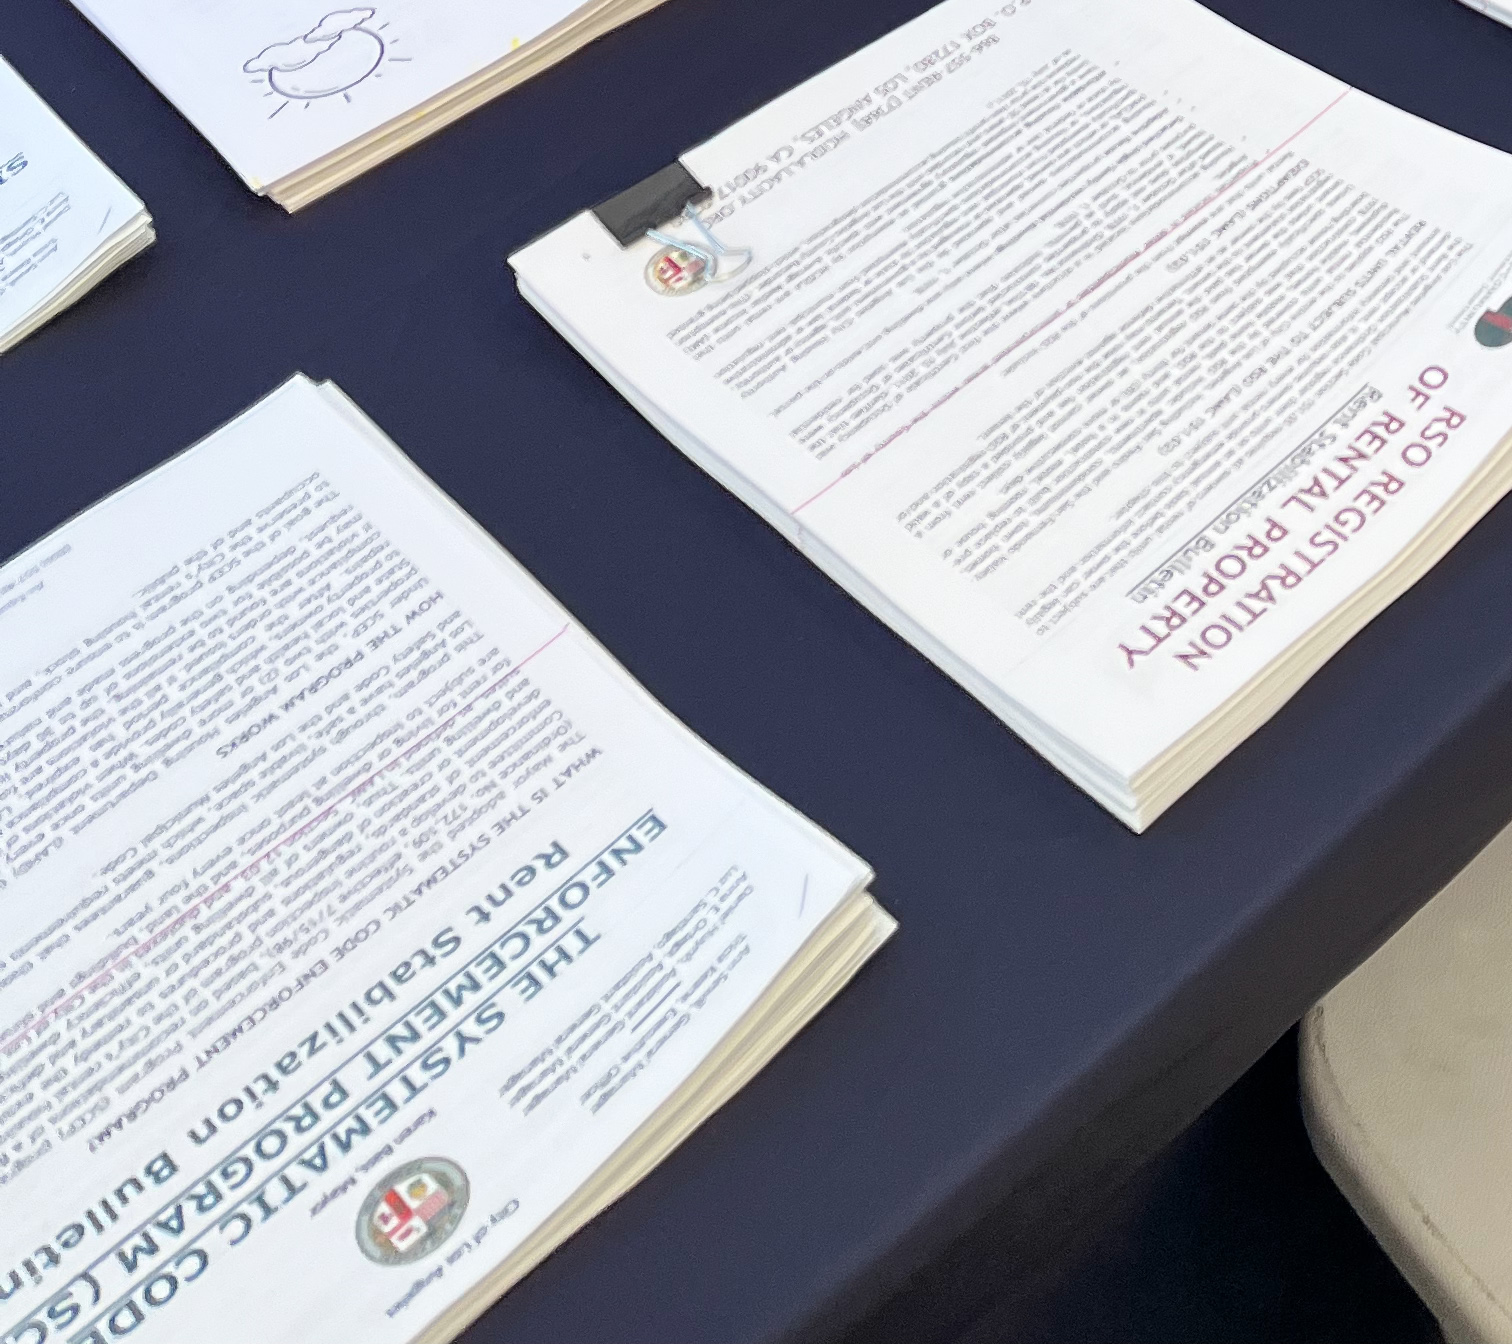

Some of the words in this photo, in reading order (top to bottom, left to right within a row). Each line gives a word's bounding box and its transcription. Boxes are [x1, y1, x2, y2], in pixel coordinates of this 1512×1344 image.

[872, 72, 908, 97] LOS
[765, 144, 794, 163] CA
[1327, 386, 1383, 428] Rent
[1407, 364, 1449, 410] OF
[1281, 410, 1405, 511] RENTAL
[1400, 405, 1466, 467] RSO
[1207, 425, 1336, 534] Stabilization
[1118, 517, 1288, 667] PROPERTY
[1131, 531, 1215, 603] Bulletin
[1175, 470, 1404, 670] REGISTRATION
[365, 623, 402, 651] THE
[404, 590, 444, 625] HOW
[278, 649, 364, 712] PROGRAM
[215, 712, 280, 758] WORKS
[556, 730, 586, 752] The
[512, 753, 553, 789] Mayor
[551, 747, 602, 790] WHAT
[446, 789, 506, 841] adopted
[490, 804, 531, 836] THE
[383, 833, 490, 920] SYSTEMATIC
[465, 840, 569, 924] Rent
[290, 927, 330, 959] Code
[329, 918, 381, 962] CODE
[364, 814, 665, 1078] ENFORCEMENT
[510, 927, 601, 1001] THE
[186, 960, 286, 1039] Enforcement
[211, 961, 260, 1001] based
[188, 927, 461, 1144] Stabilization
[195, 959, 328, 1069] ENFORCEMENT
[114, 1039, 184, 1095] Program
[219, 1003, 504, 1245] SYSTEMATIC
[116, 1078, 348, 1272] PROGRAM
[0, 1151, 178, 1299] Bulletin
